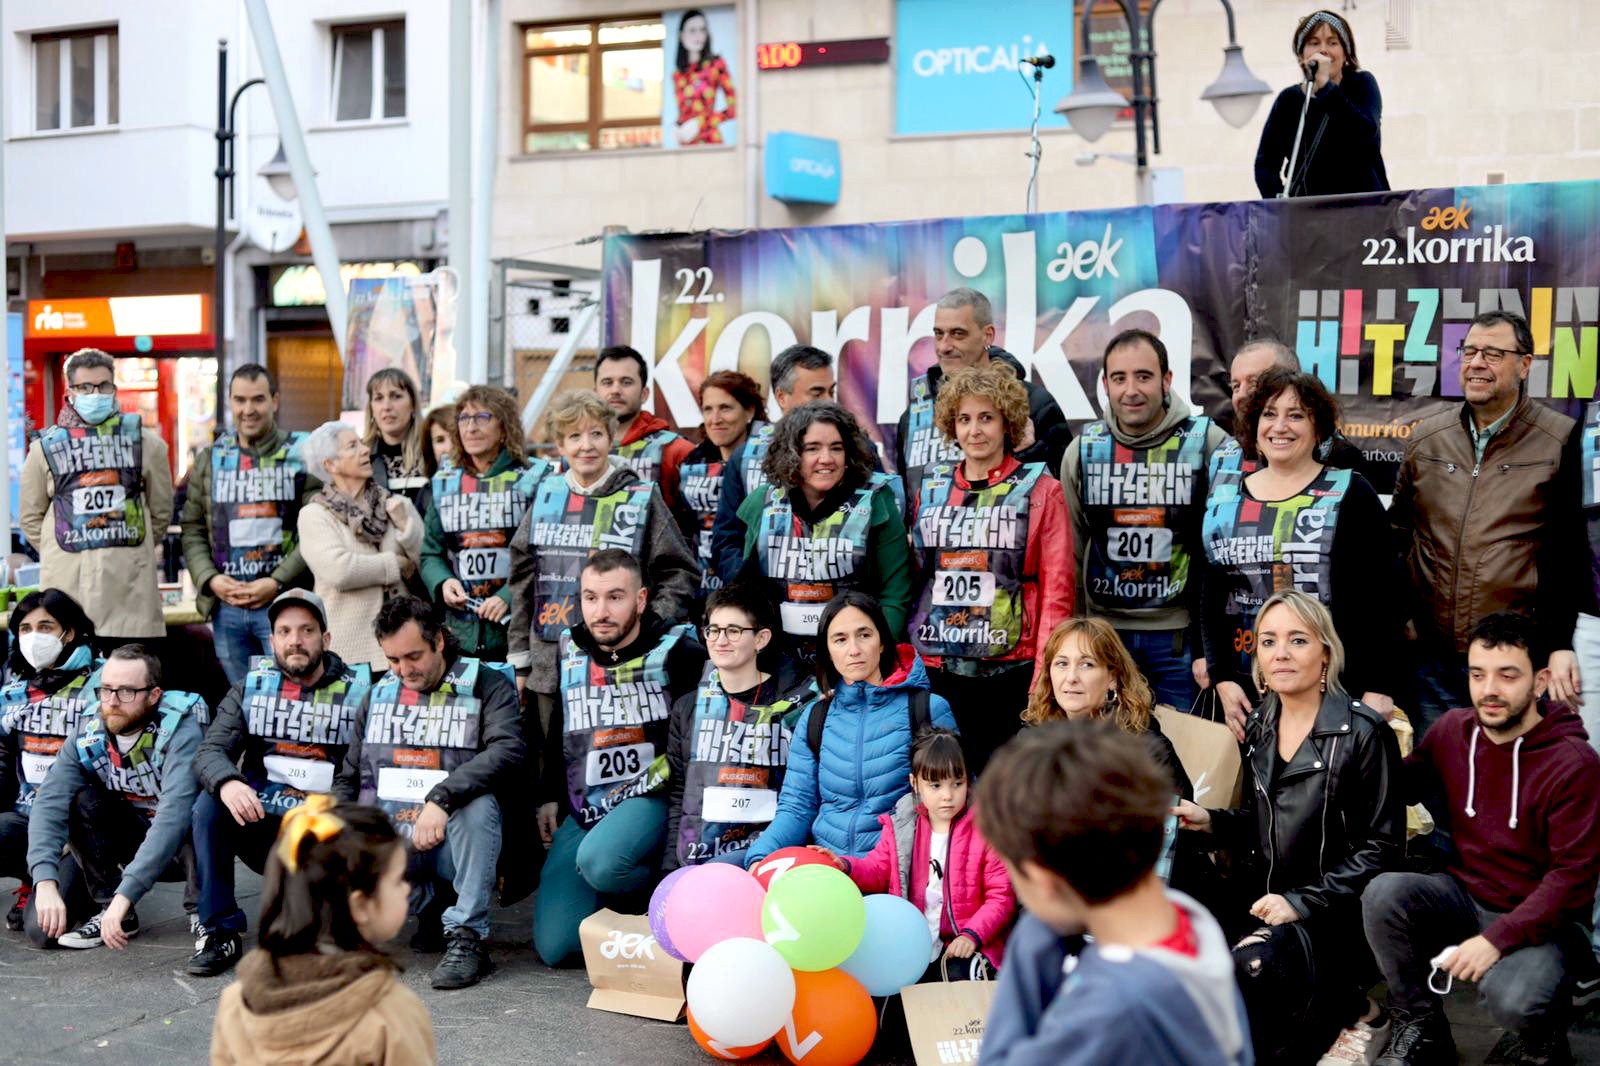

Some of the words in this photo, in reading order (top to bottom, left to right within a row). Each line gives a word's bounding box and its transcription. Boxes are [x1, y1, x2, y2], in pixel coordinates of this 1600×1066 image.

[1421, 198, 1472, 230] aek
[1046, 222, 1124, 282] aek
[674, 266, 725, 304] 22.
[1087, 462, 1192, 505] HITZEKIN
[84, 491, 114, 511] 207
[919, 506, 1017, 549] HITZEKIN
[1118, 531, 1153, 559] 201
[466, 553, 497, 576] 207
[944, 575, 981, 601] 205
[538, 594, 574, 626] aek
[918, 620, 1008, 645] 22.korrika
[287, 767, 306, 778] 203
[600, 749, 641, 779] 203
[406, 777, 424, 789] 203
[731, 798, 751, 809] 207
